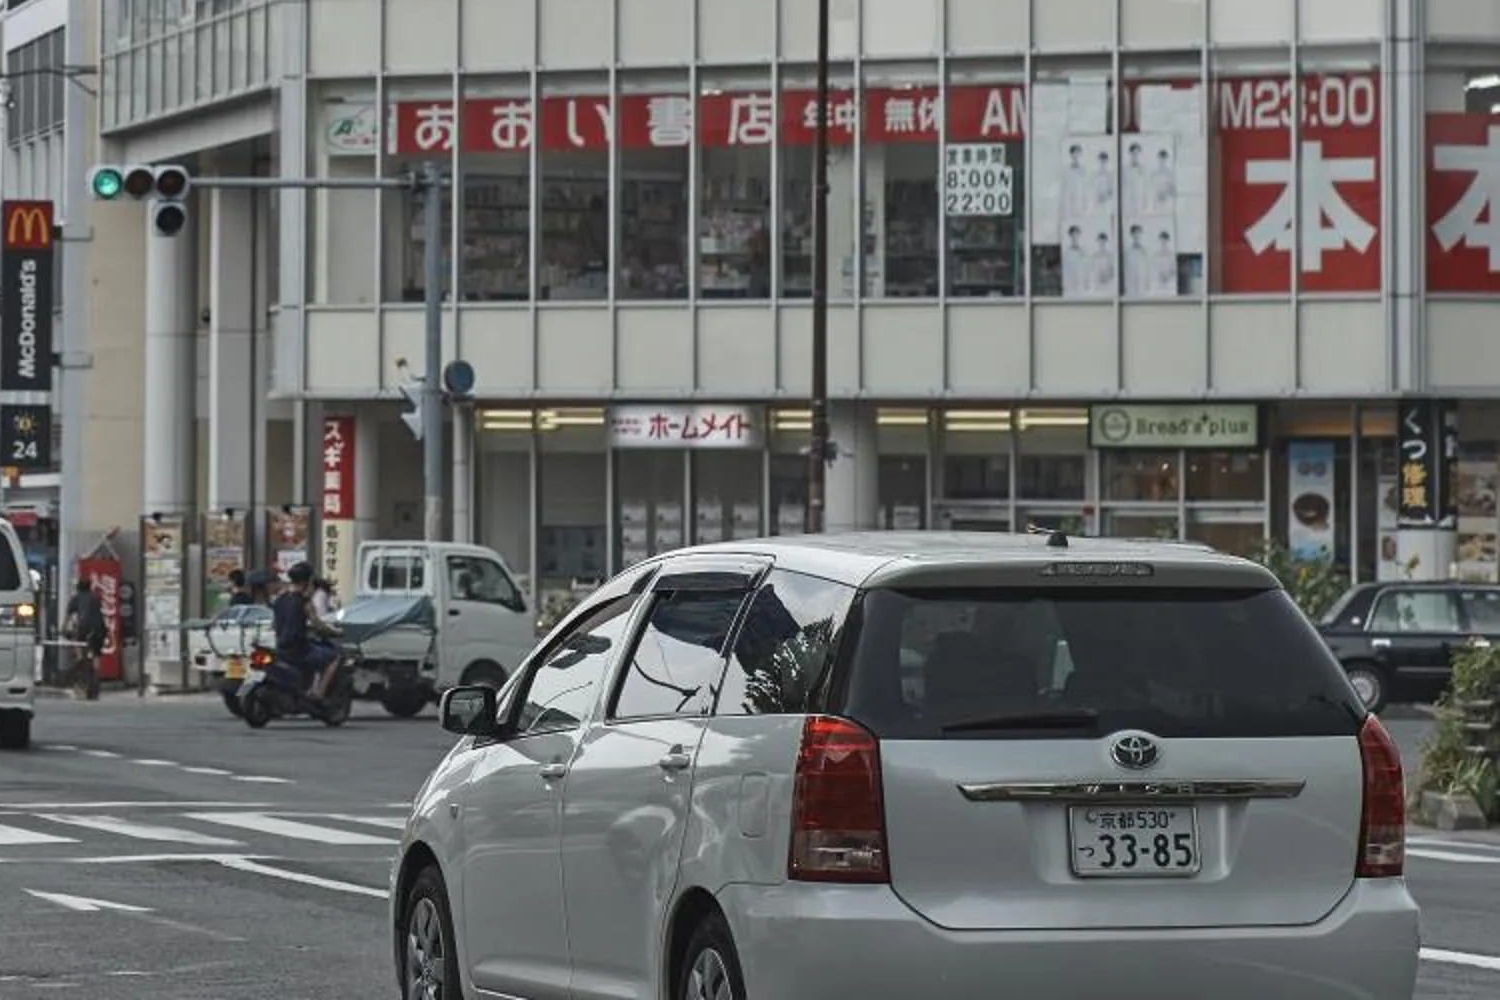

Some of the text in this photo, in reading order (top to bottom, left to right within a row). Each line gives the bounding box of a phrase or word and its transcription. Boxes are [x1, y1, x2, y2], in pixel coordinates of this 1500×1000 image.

[415, 94, 773, 149] おおい書店
[947, 192, 1010, 212] 22:00
[1244, 140, 1378, 273] 本
[18, 259, 37, 379] McDonald's
[648, 413, 751, 439] ホームメイト
[13, 441, 38, 459] 24
[1099, 811, 1169, 829] 京都530
[1098, 833, 1192, 867] 33-85
